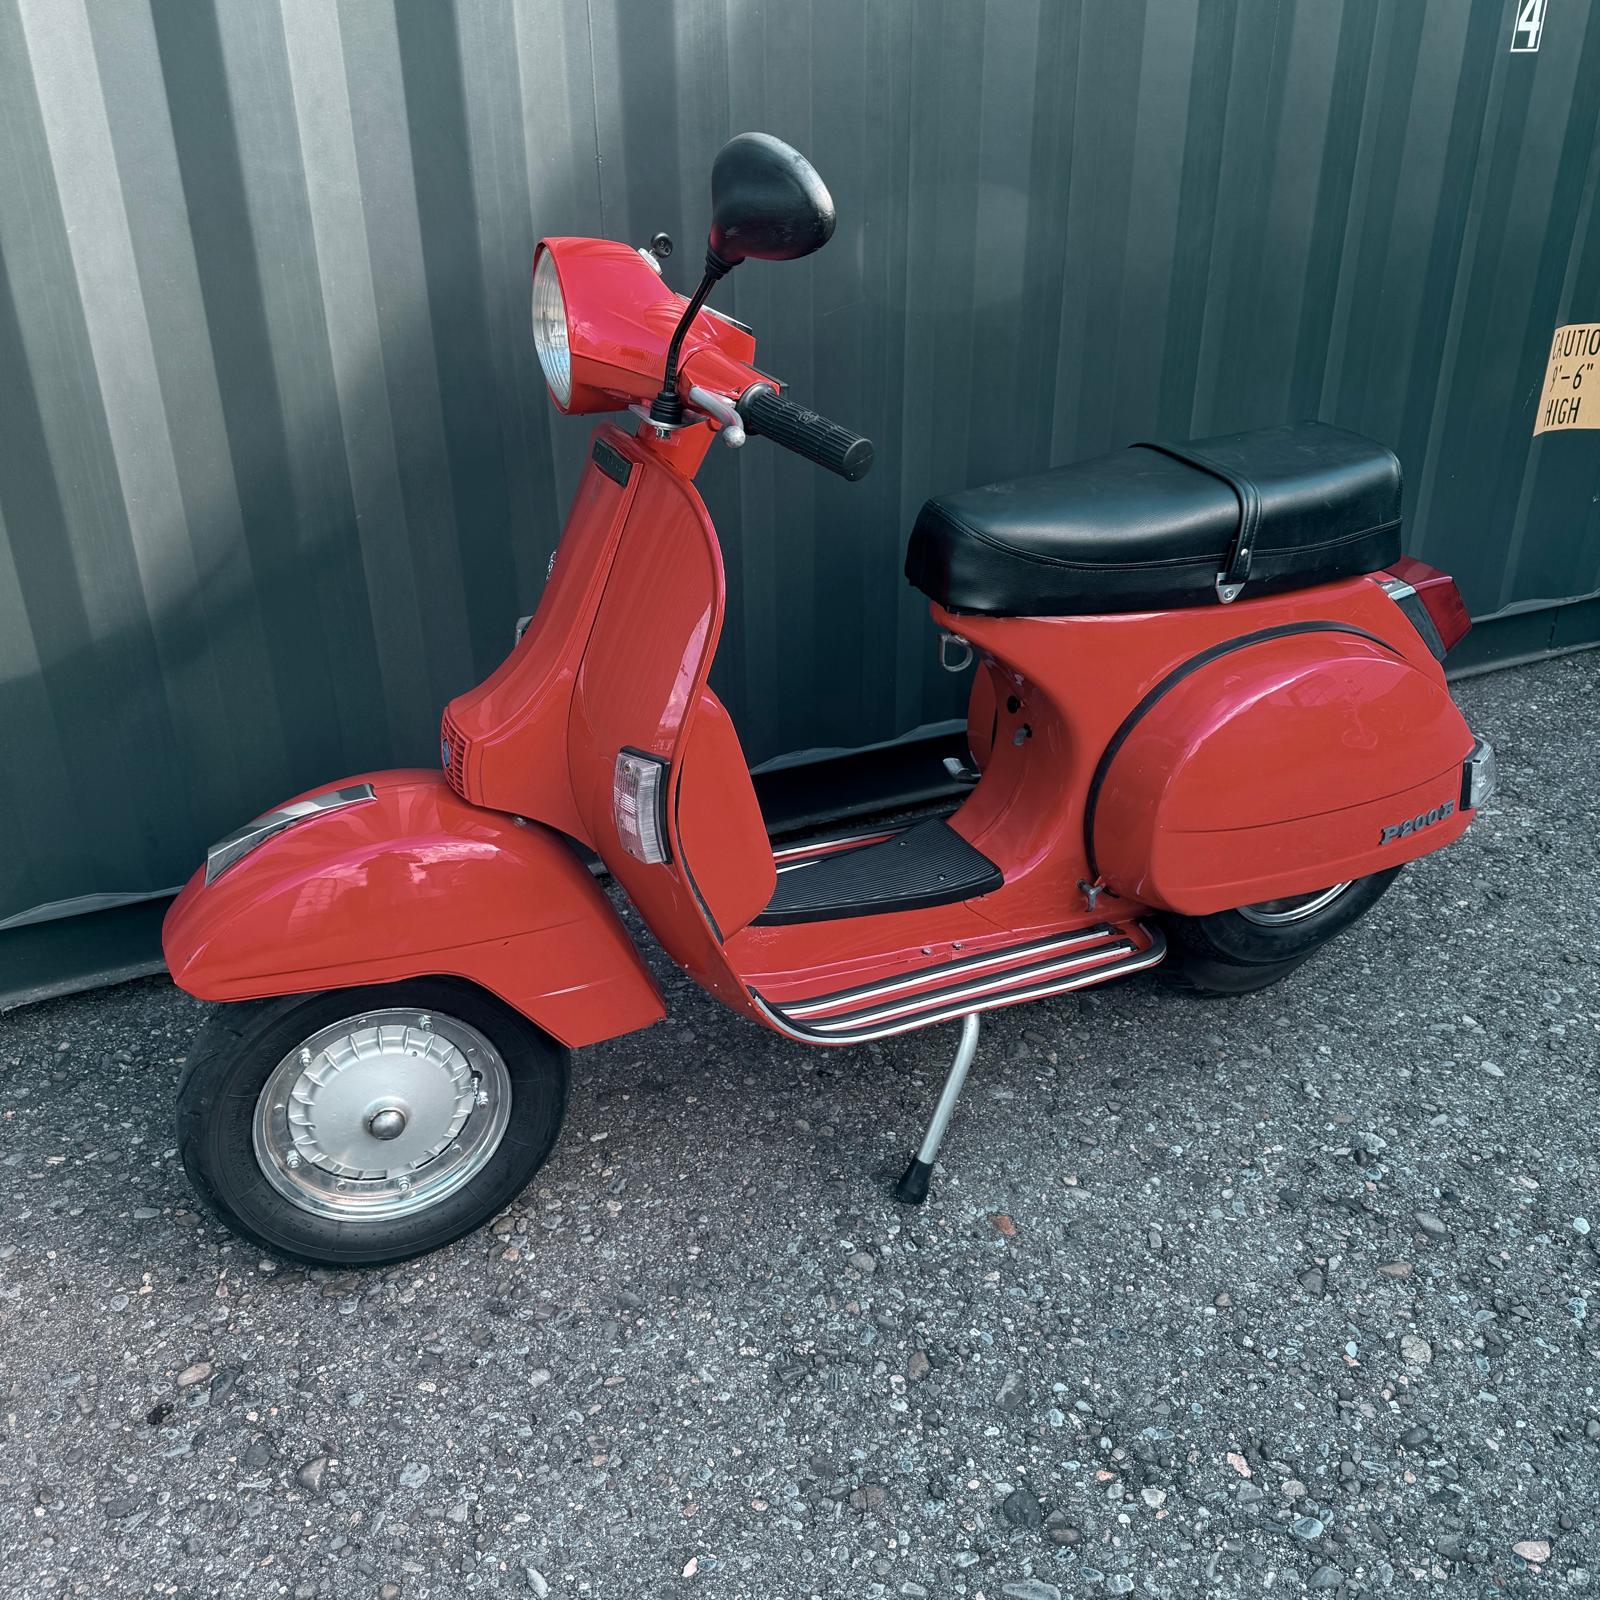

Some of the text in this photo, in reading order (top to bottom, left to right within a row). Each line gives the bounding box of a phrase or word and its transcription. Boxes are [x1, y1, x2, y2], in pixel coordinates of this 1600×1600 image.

[1517, 0, 1541, 48] 4
[1543, 397, 1582, 427] HIGH
[1378, 799, 1456, 846] P200E
